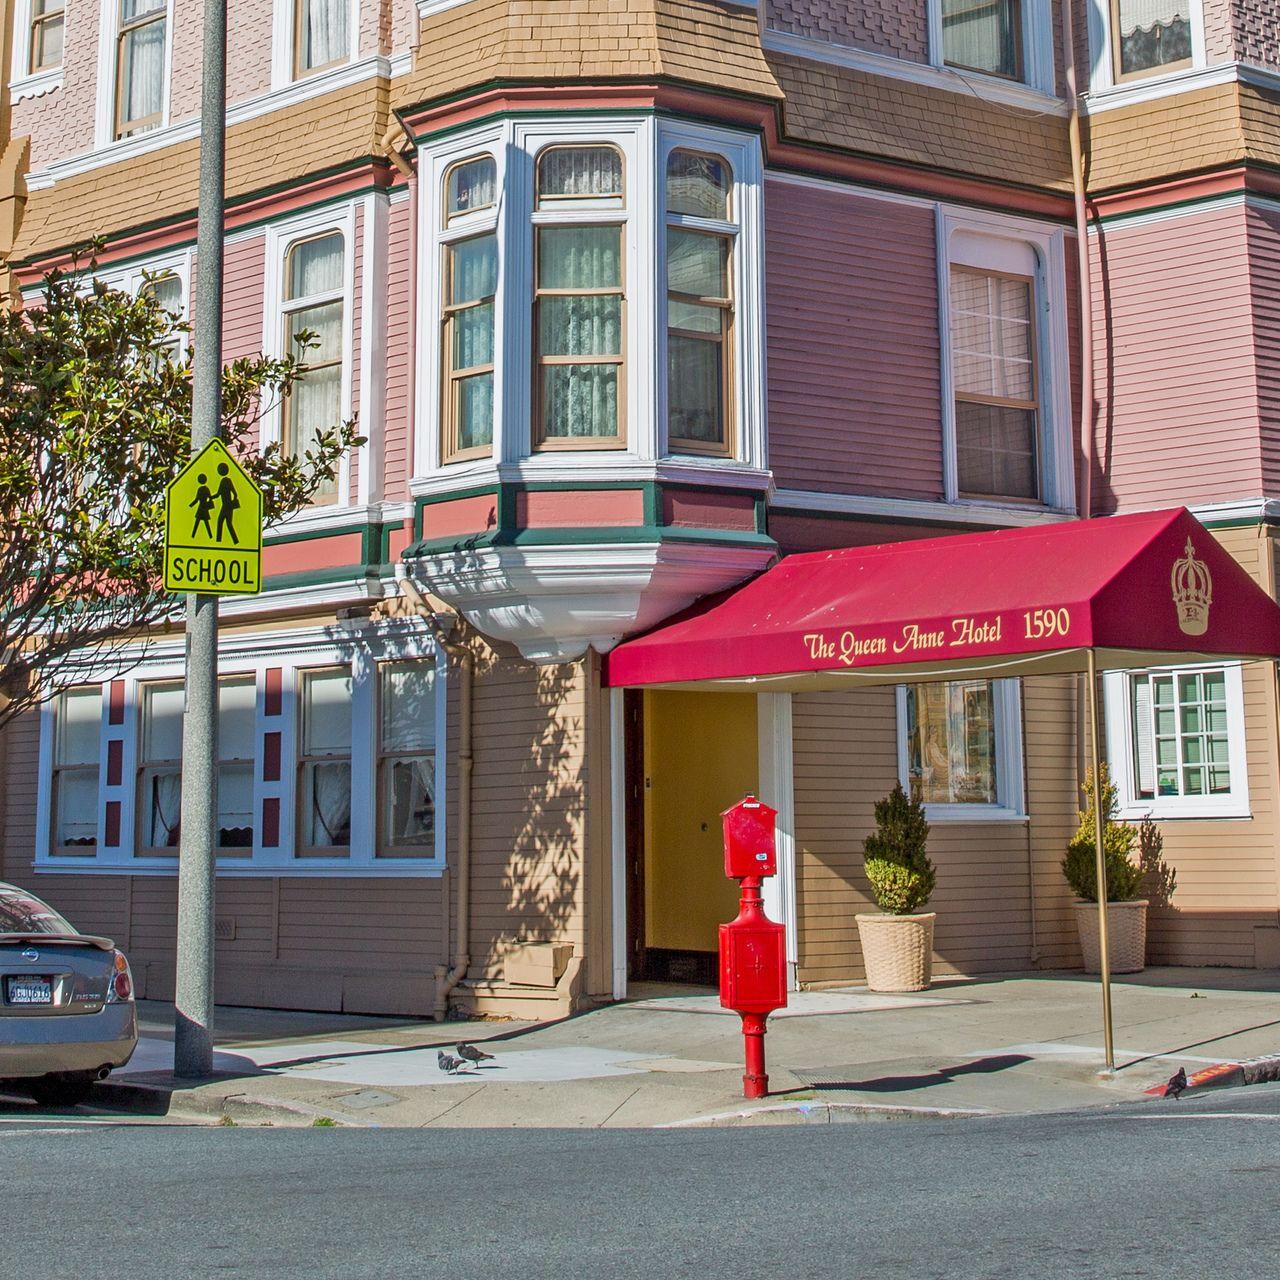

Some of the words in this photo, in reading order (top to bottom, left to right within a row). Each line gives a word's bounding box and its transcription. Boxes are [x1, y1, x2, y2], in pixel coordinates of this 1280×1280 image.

[172, 557, 254, 584] SCHOOL
[804, 634, 835, 659] The
[838, 631, 887, 665] Queen
[893, 624, 945, 654] Anne
[950, 615, 1002, 646] Hotel
[1024, 607, 1070, 639] 1590
